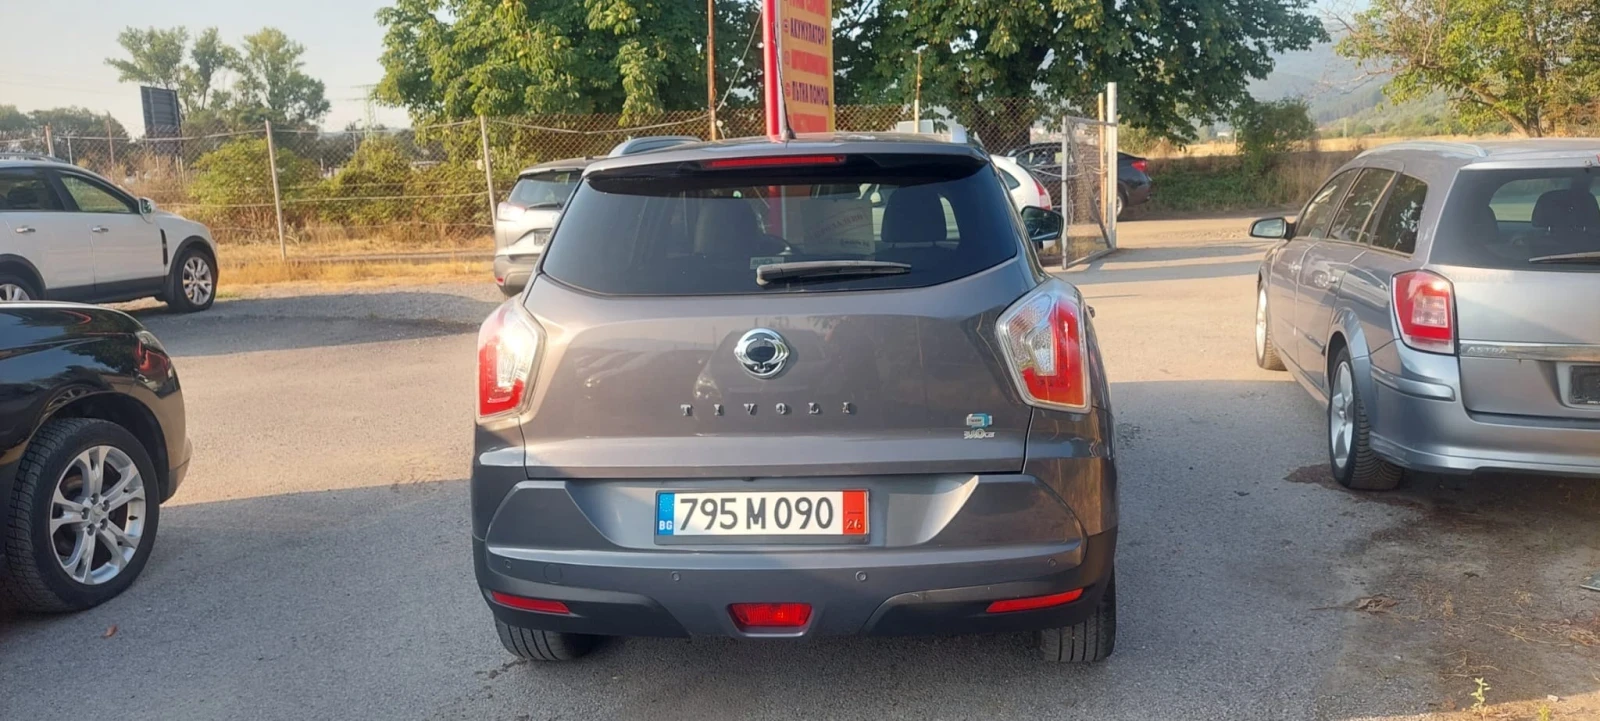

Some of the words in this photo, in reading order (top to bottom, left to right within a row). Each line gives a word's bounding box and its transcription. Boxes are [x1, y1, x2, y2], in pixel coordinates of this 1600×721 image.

[792, 80, 809, 103] ПЪТНА
[810, 84, 829, 107] ПОМОЩ
[1467, 346, 1508, 354] ASTRA
[679, 497, 739, 531] 795
[746, 497, 767, 530] M
[773, 496, 834, 530] 090
[659, 520, 673, 531] BG
[846, 518, 863, 530] 26
